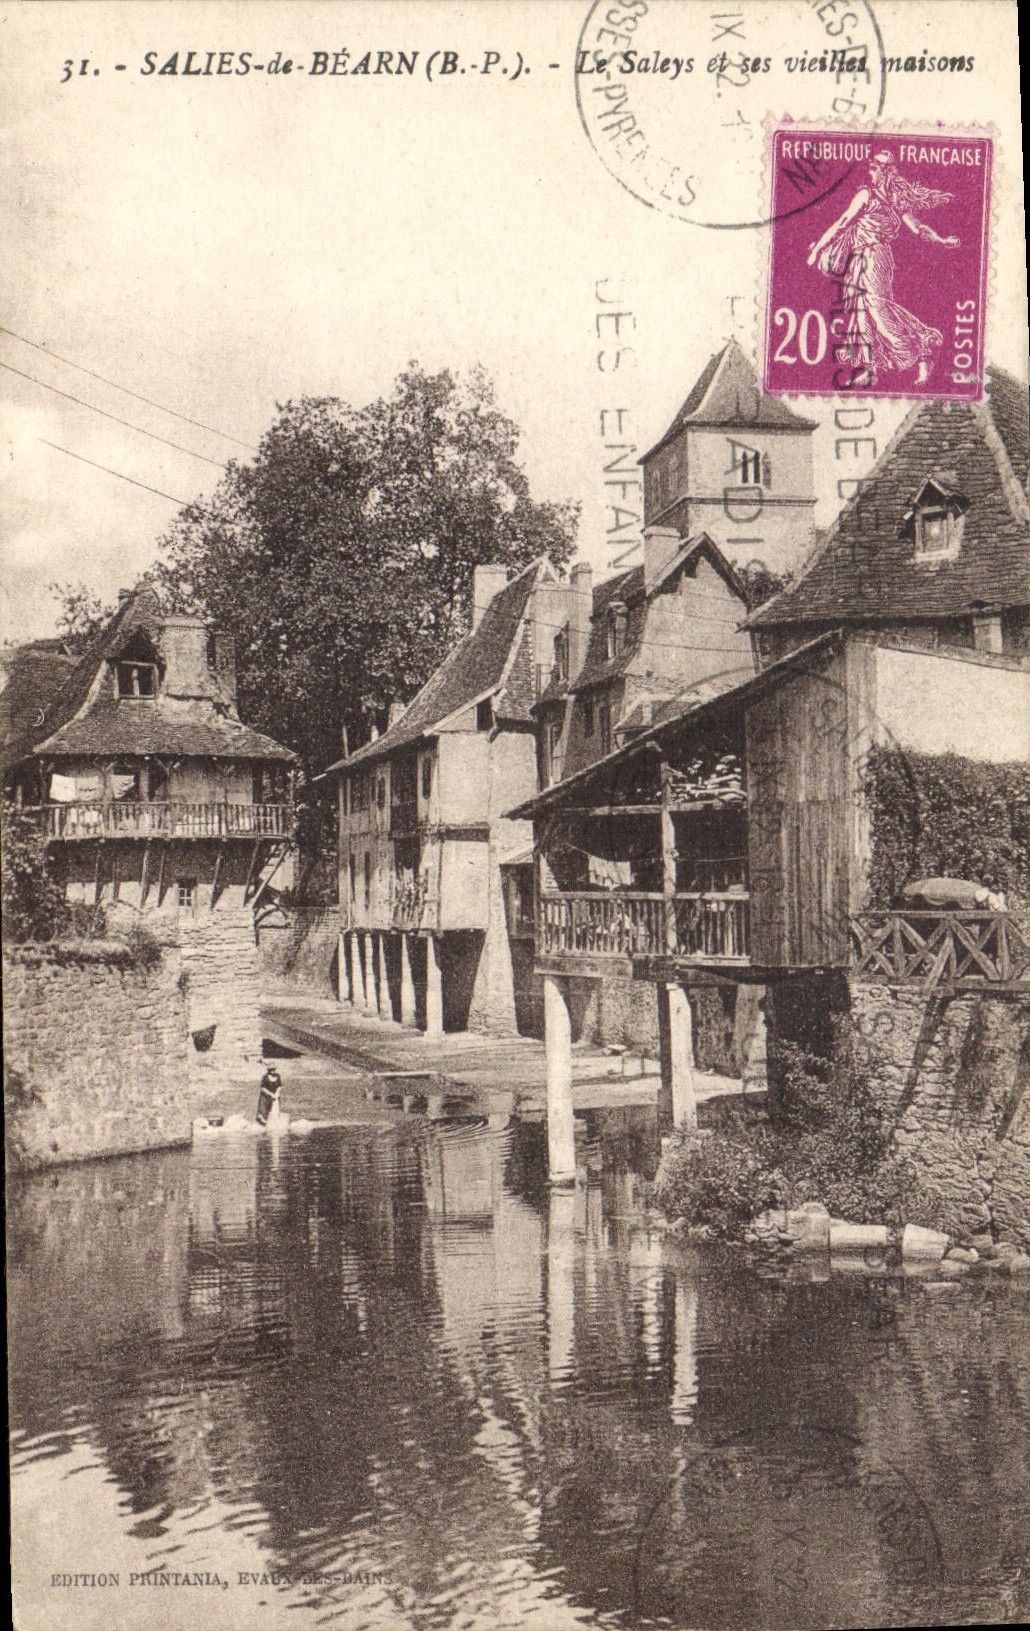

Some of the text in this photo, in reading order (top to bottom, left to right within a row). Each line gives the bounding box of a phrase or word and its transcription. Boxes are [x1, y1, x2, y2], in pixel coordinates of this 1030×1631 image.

[899, 144, 983, 167] FRANÇAISE
[952, 299, 976, 384] POSTES
[833, 407, 878, 461] DE
